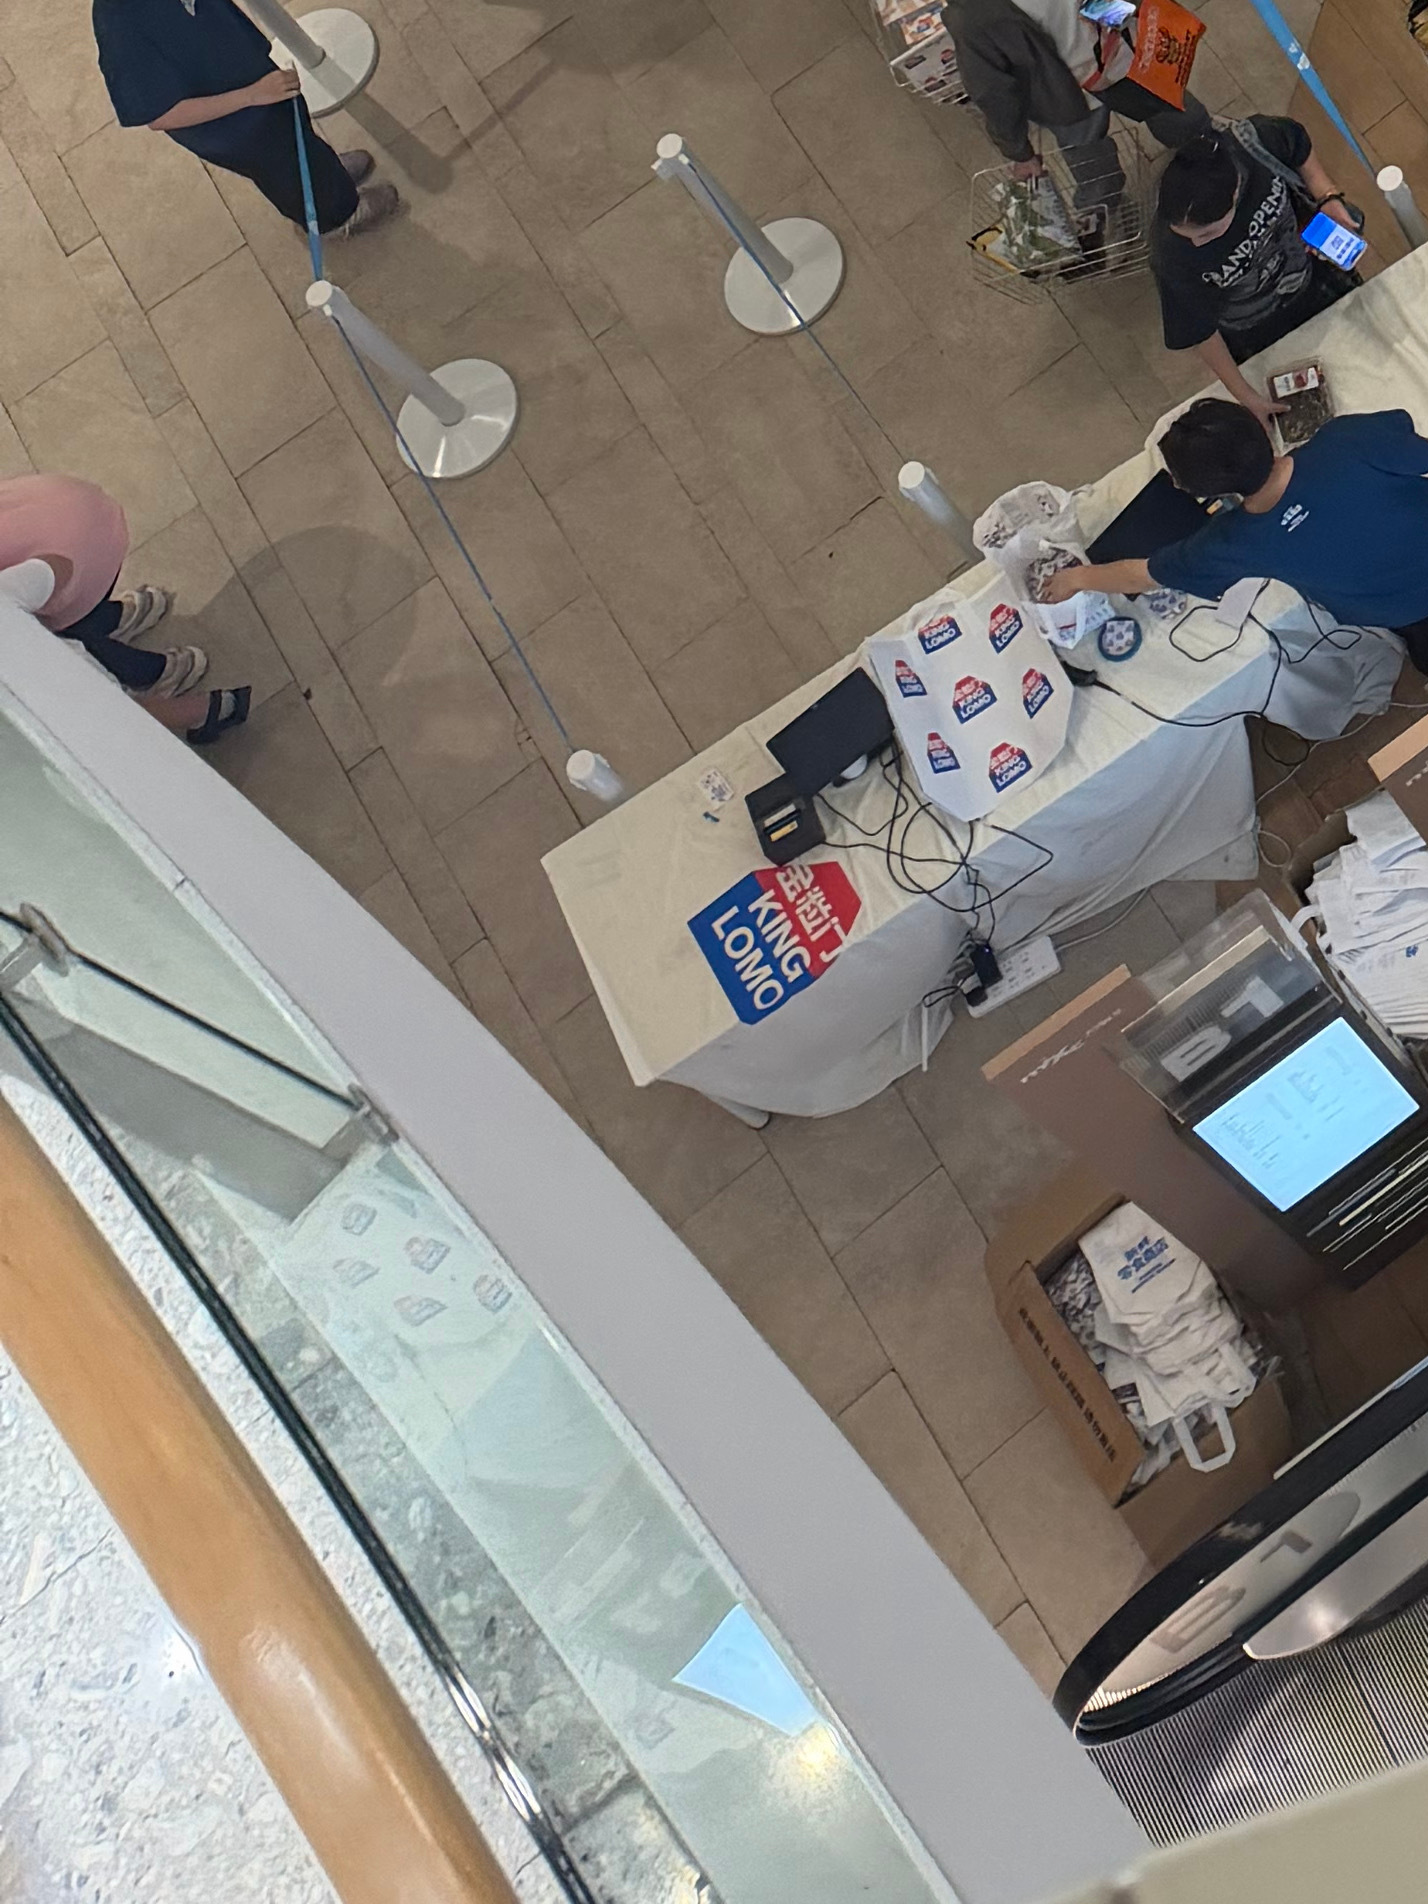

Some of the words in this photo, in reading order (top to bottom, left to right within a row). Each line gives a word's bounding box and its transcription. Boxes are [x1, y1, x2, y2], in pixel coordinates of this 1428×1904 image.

[961, 694, 992, 719] LOMO
[996, 760, 1028, 787] LOMO
[711, 905, 785, 1011] LOMO
[748, 889, 812, 984] KING
[775, 863, 852, 964] 金粒门
